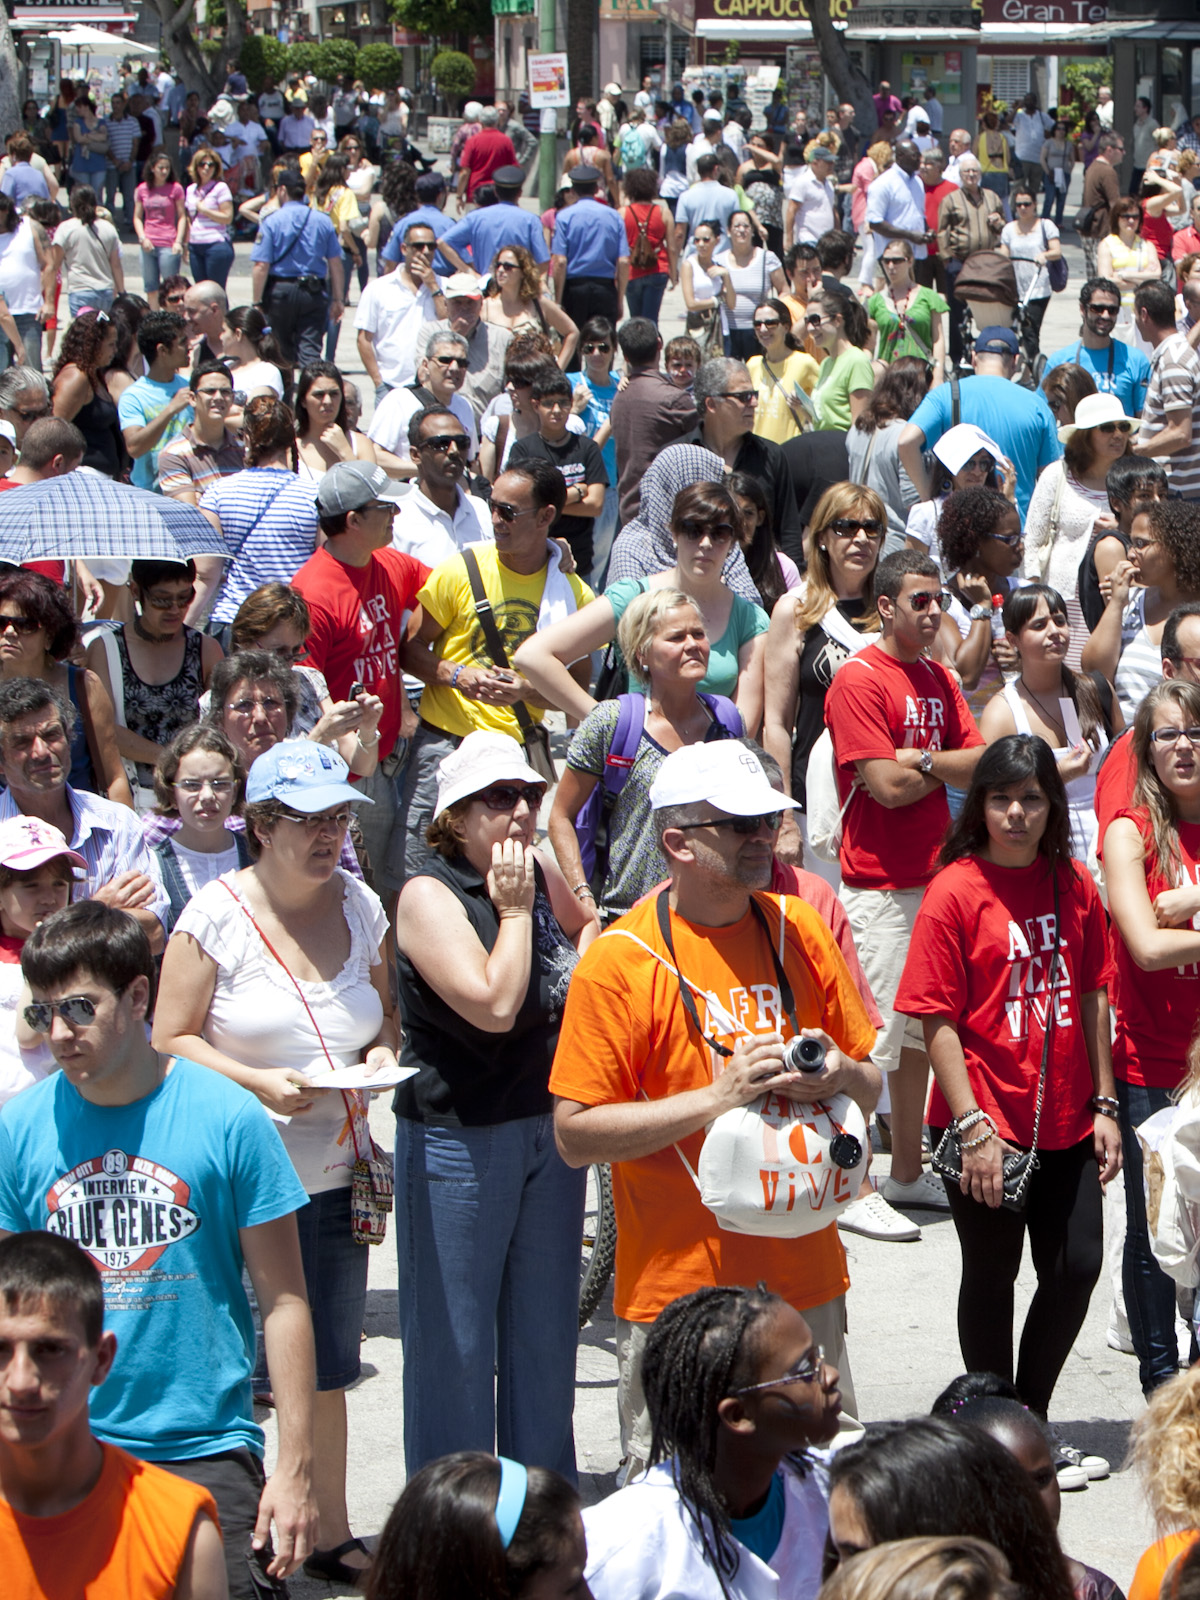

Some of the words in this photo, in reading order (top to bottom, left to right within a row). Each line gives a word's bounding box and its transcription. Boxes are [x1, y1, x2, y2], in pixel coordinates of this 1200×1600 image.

[1003, 0, 1064, 20] Gran
[359, 594, 391, 633] AFR
[903, 695, 944, 727] AFR
[1007, 914, 1068, 960] AFR
[1008, 953, 1071, 997] ICA
[703, 984, 787, 1038] AFR
[1005, 990, 1072, 1037] ViVE
[75, 1160, 94, 1180] CITY
[105, 1153, 126, 1173] 89
[84, 1179, 148, 1196] INTERVIEW
[760, 1169, 851, 1211] ViVE
[57, 1200, 107, 1248] BLUE
[112, 1198, 182, 1248] GENES
[104, 1251, 130, 1268] 1975
